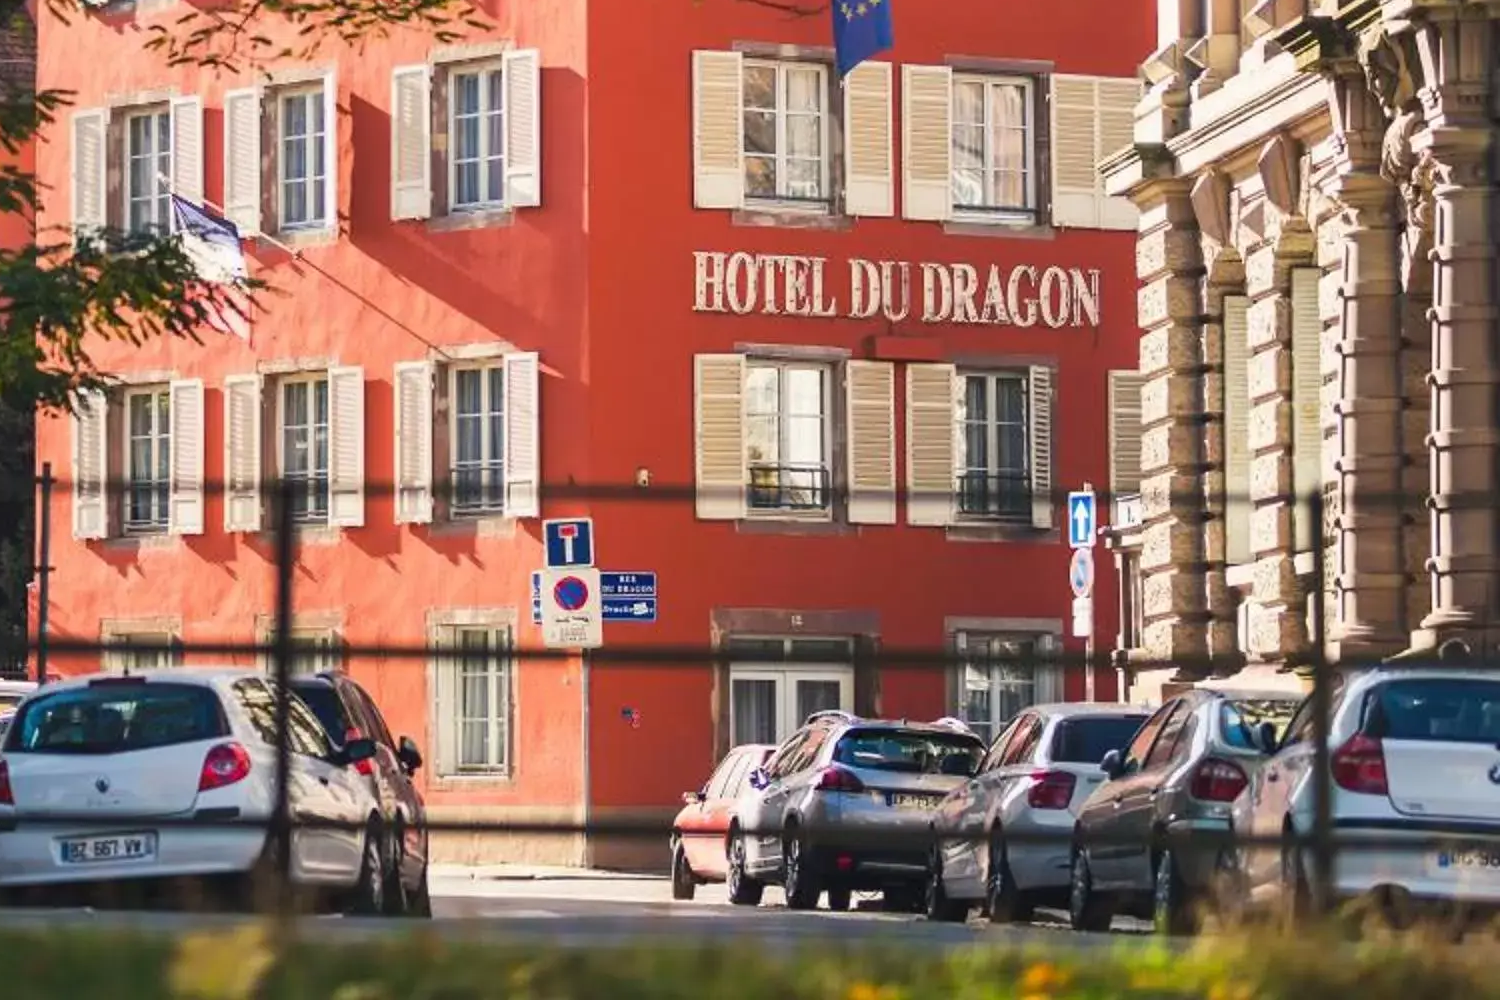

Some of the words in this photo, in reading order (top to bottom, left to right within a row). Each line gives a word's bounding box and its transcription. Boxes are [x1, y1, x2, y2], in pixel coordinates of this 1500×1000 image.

[691, 251, 836, 317] HOTEL
[848, 257, 911, 321] DU
[920, 262, 1101, 328] DRAGON
